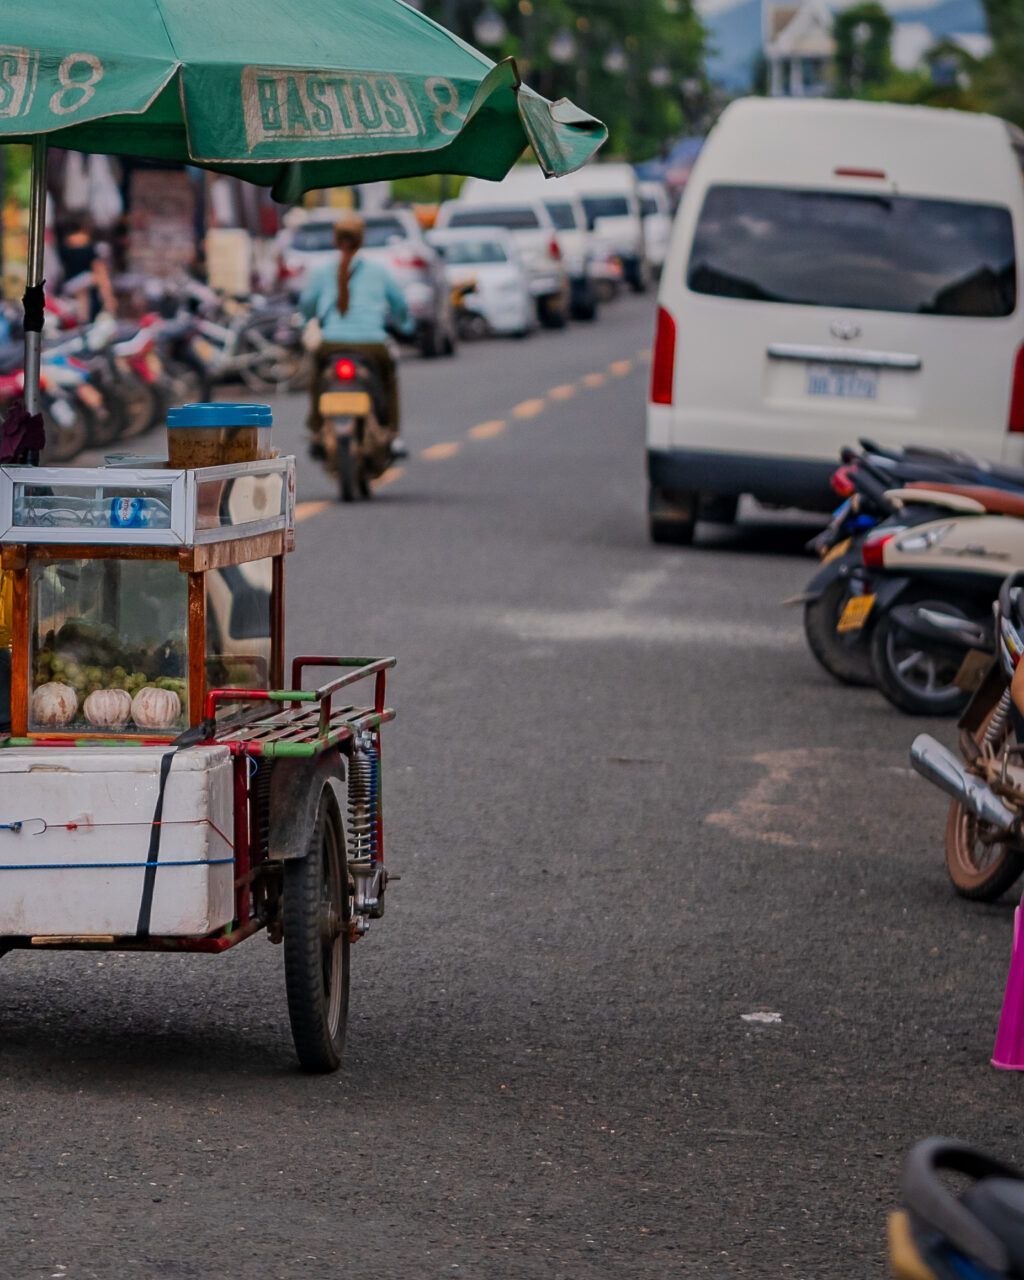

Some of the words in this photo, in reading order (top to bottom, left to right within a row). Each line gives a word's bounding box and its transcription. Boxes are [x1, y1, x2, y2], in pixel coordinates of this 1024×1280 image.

[49, 52, 105, 115] 8
[256, 74, 408, 132] BASTOS
[425, 76, 467, 135] 8
